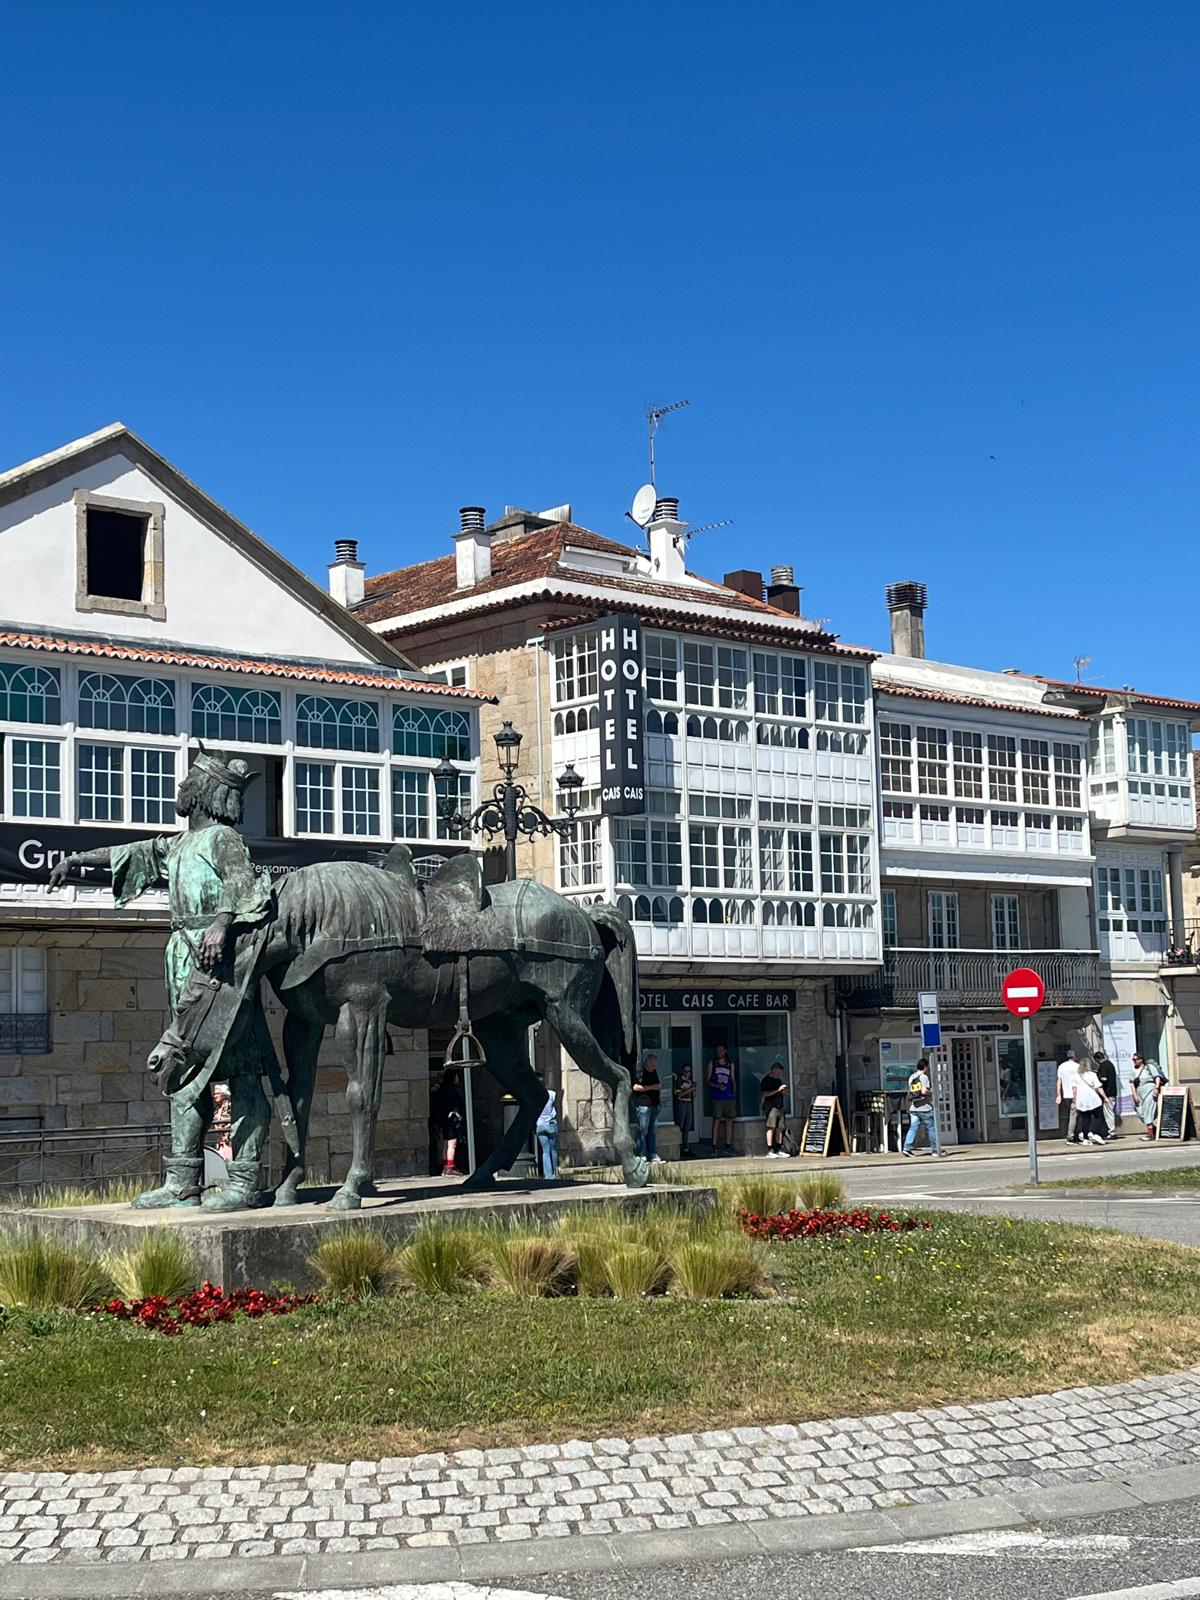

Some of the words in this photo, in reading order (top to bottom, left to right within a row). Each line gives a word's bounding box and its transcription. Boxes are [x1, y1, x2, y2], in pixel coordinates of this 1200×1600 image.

[601, 628, 617, 770] HOTEL
[622, 628, 639, 770] HOTEL
[602, 786, 621, 800] CAIS
[624, 786, 643, 800] CAIS
[640, 994, 668, 1008] OTEL
[682, 994, 714, 1008] CAIS
[727, 994, 759, 1007] CAFE
[766, 994, 789, 1007] BAR
